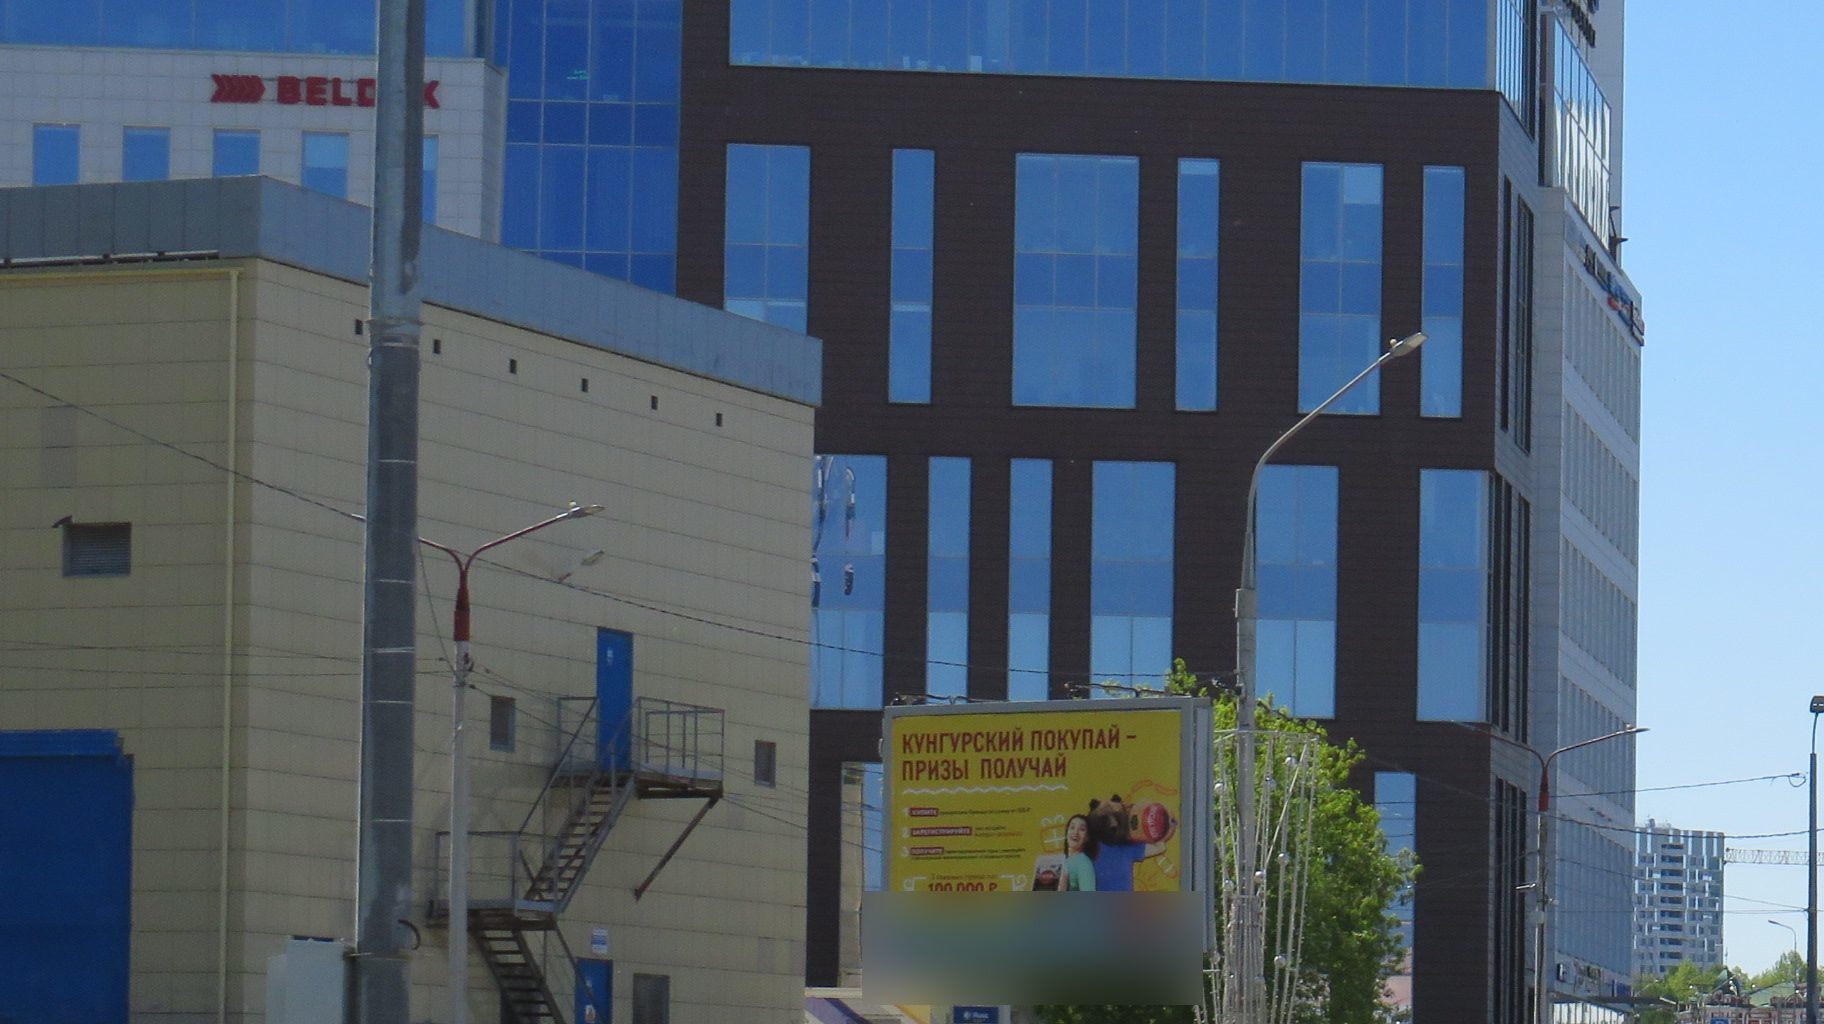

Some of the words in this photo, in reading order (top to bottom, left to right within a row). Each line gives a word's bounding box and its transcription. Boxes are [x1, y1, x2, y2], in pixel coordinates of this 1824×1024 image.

[902, 728, 1024, 754] КУНГУРСКИЙ
[1031, 724, 1120, 751] ПОКУПАЙ
[902, 759, 969, 781] ПРИЗЫ
[980, 754, 1067, 780] ПОЛУЧАЙ
